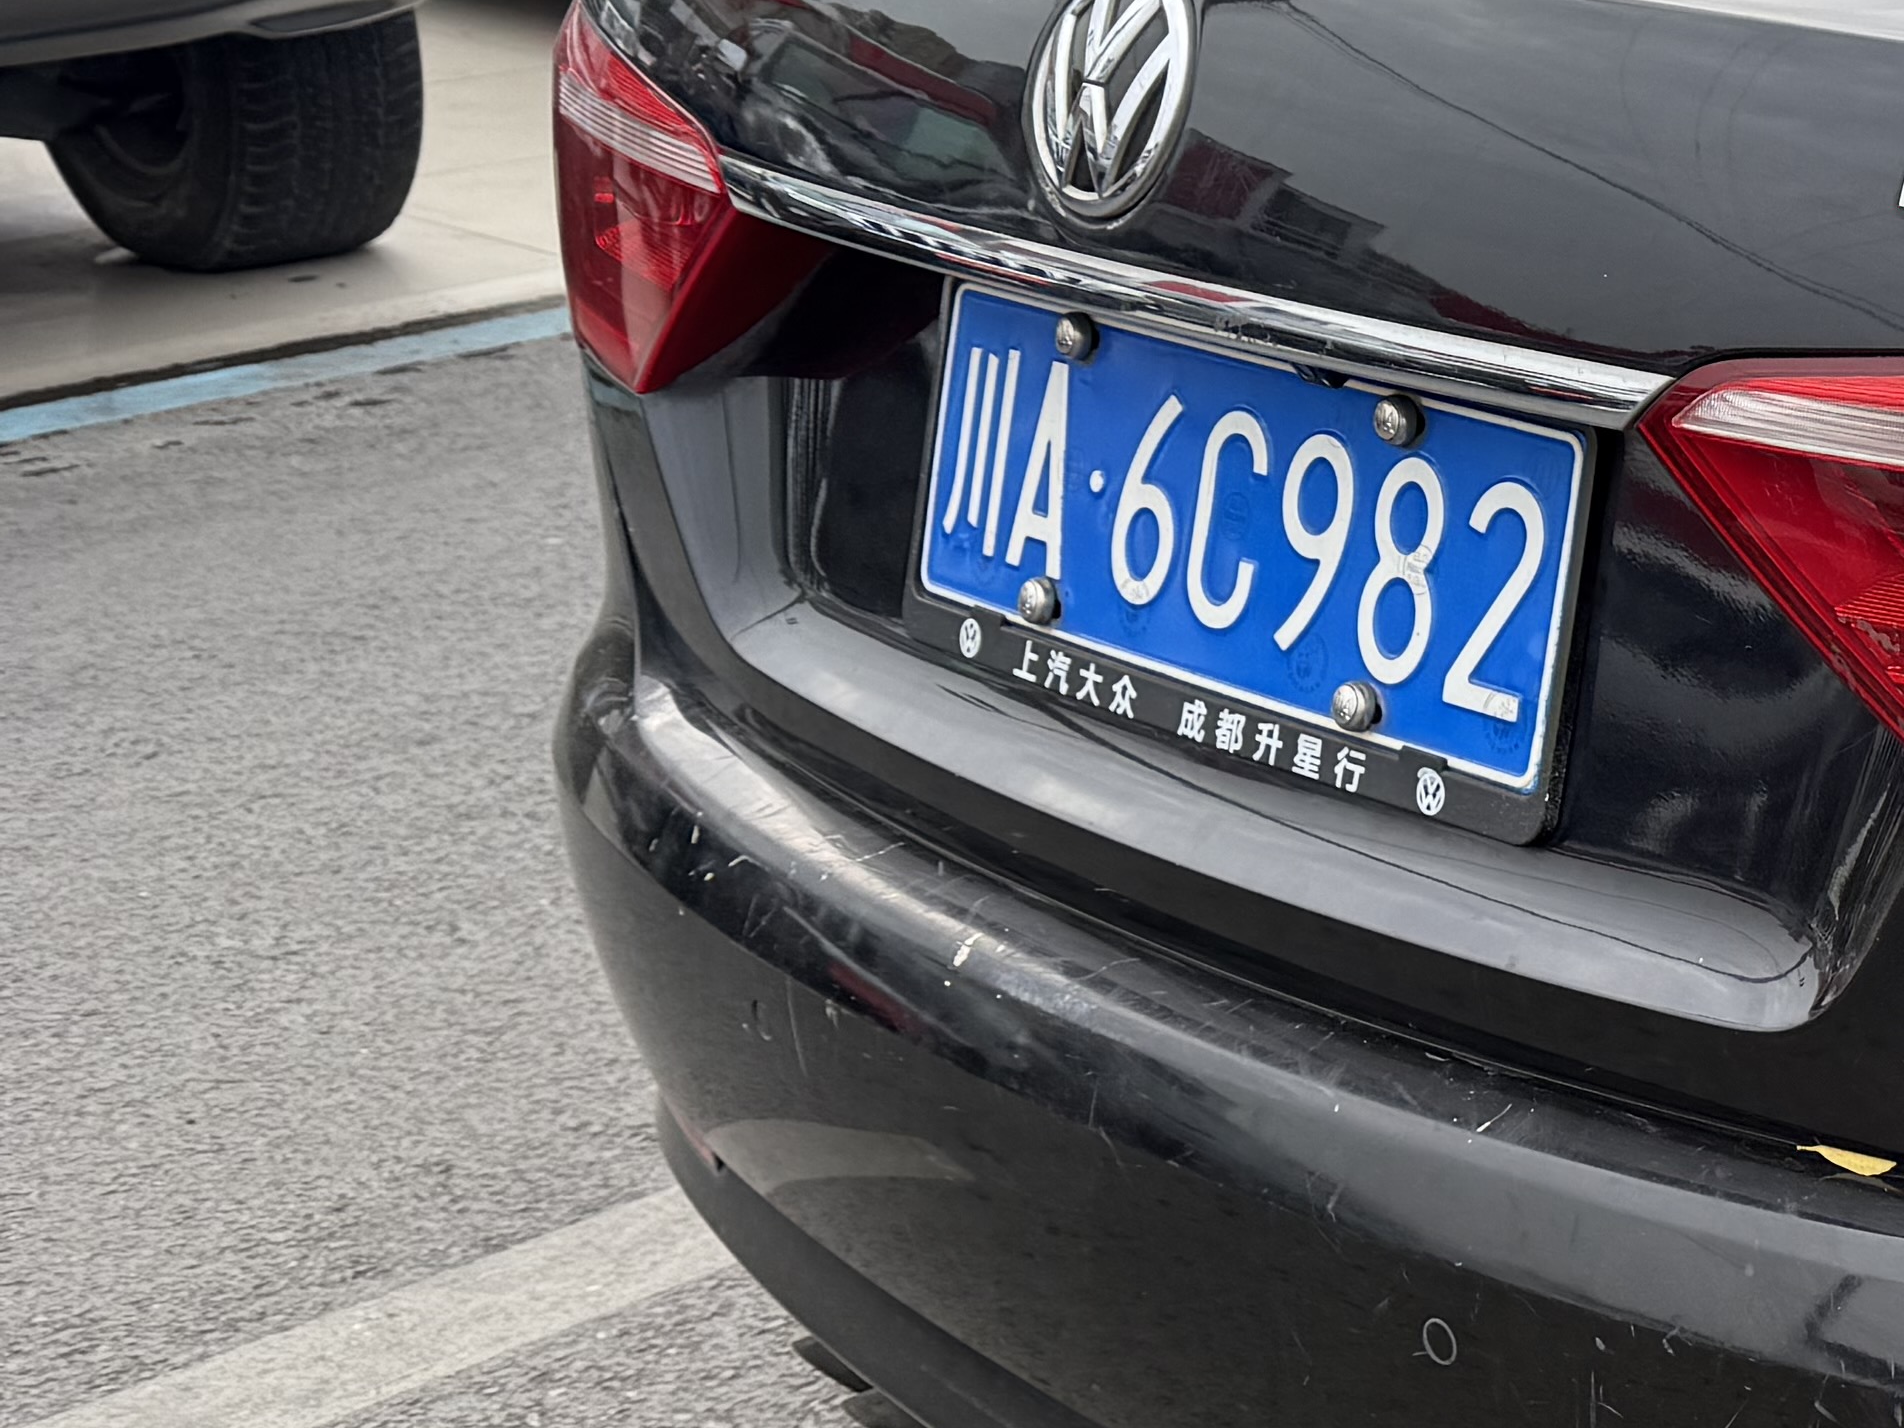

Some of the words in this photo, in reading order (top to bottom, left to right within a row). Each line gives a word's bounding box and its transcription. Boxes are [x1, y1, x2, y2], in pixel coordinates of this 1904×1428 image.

[942, 346, 1547, 723] 川A·6C982
[1012, 639, 1138, 720] 上汽大众
[1176, 697, 1367, 794] 成都升星行
